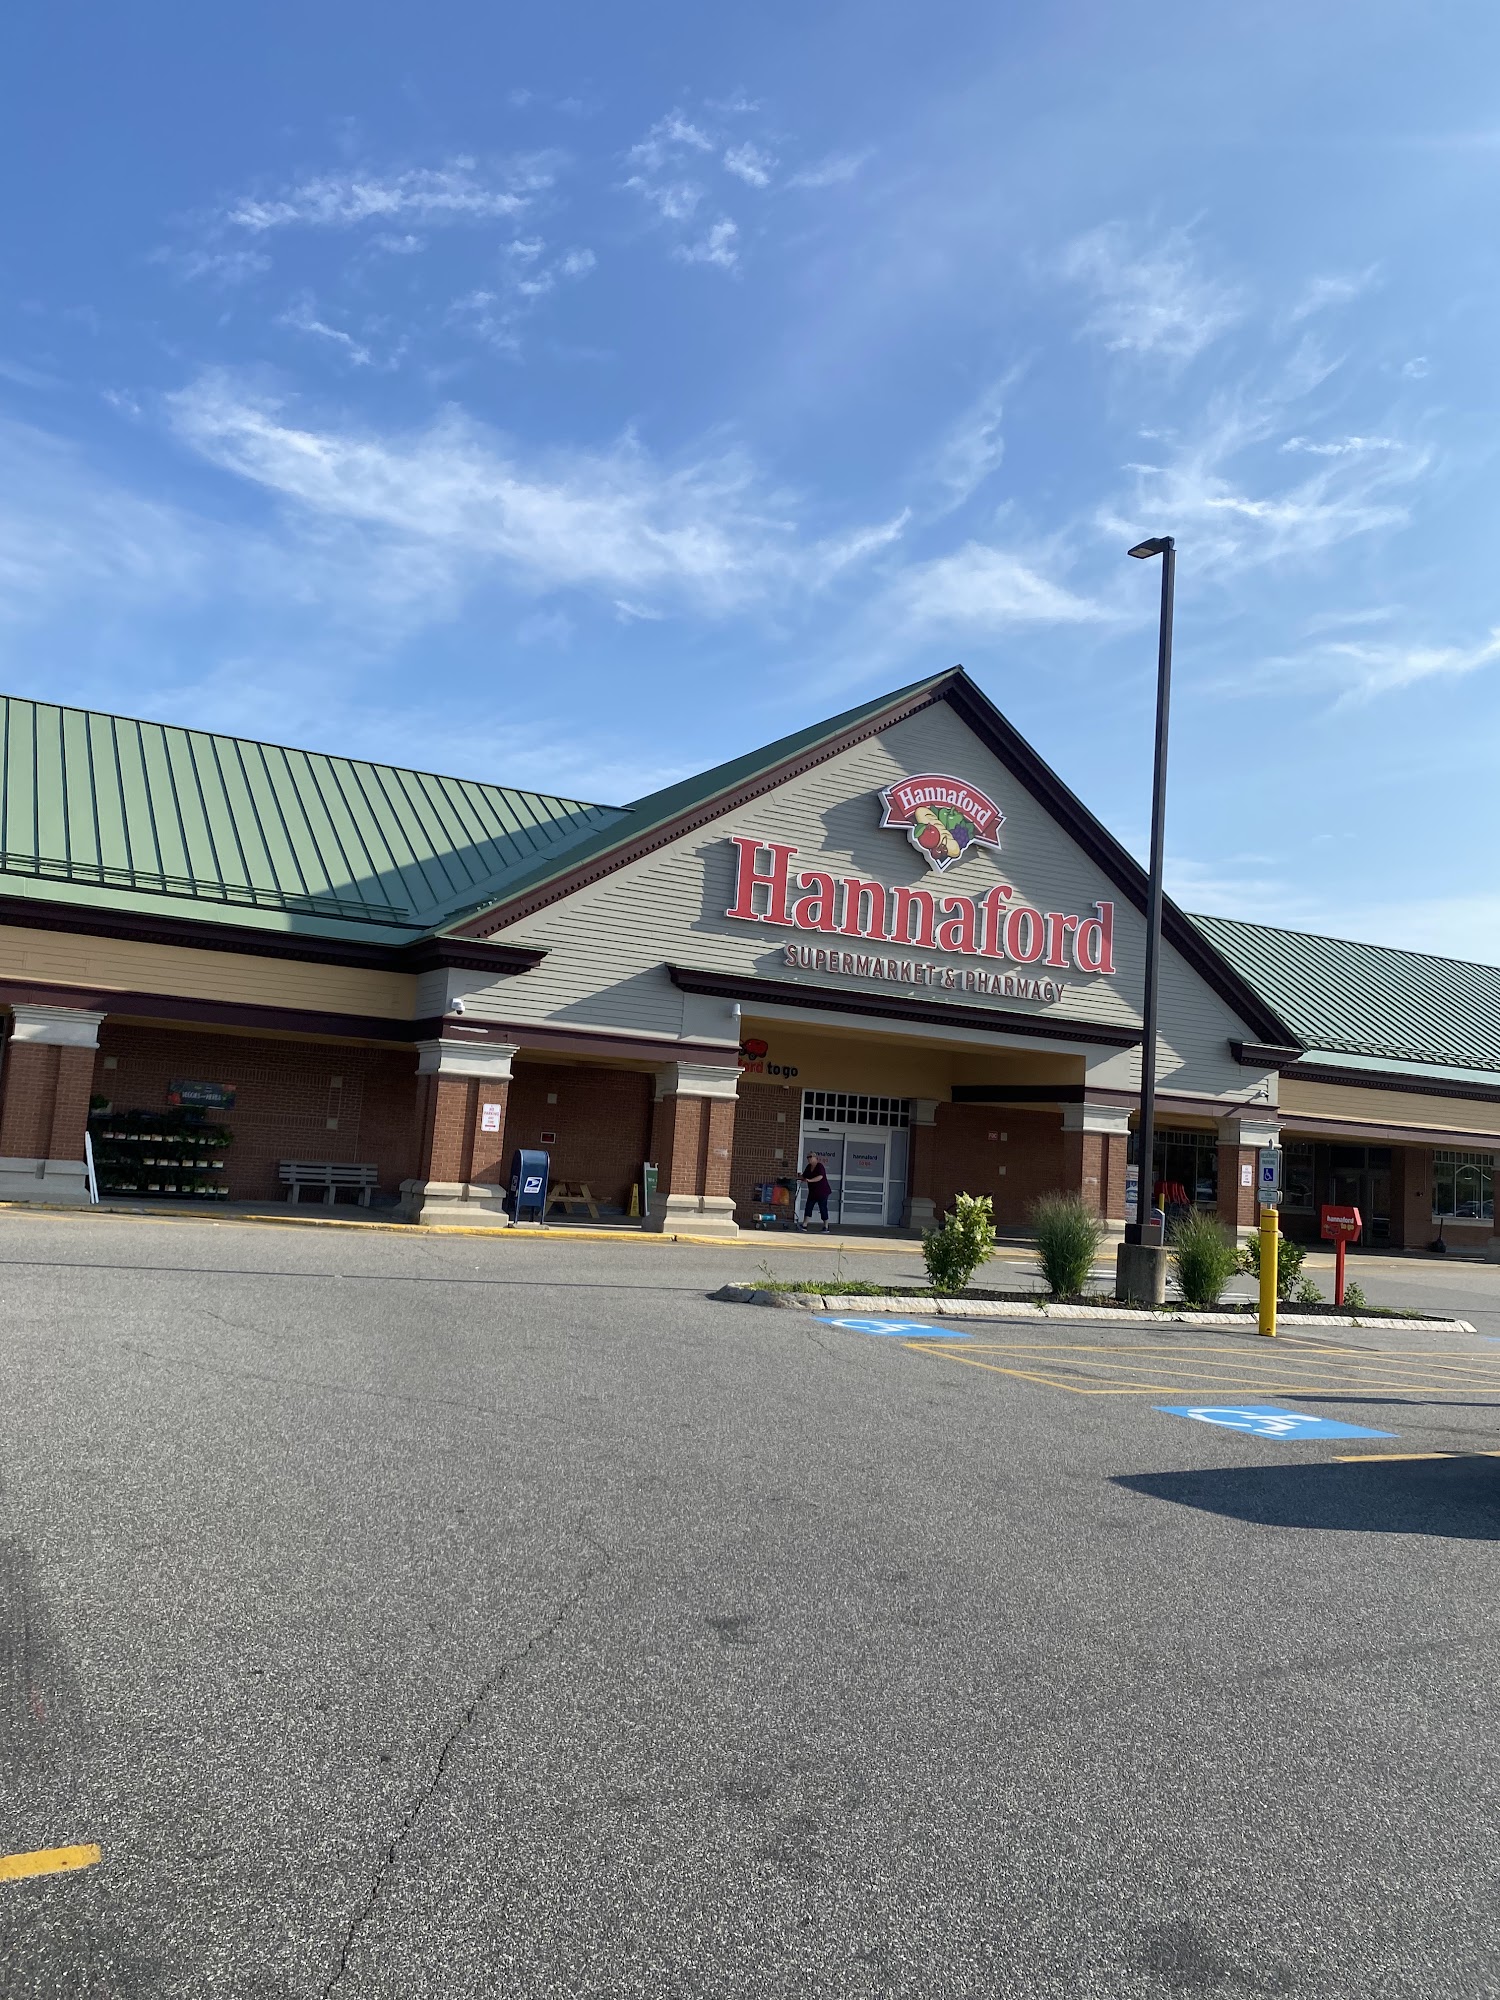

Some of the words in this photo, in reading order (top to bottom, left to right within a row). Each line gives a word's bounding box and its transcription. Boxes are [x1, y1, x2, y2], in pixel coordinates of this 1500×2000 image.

[897, 786, 992, 827] Hannaford
[725, 836, 1117, 975] Hannaford
[784, 944, 937, 986] SUPERMARKET
[941, 967, 956, 989] &
[962, 970, 1066, 1002] PHARMACY
[767, 1061, 780, 1075] to
[782, 1066, 799, 1079] go
[1326, 1215, 1355, 1224] hannaford
